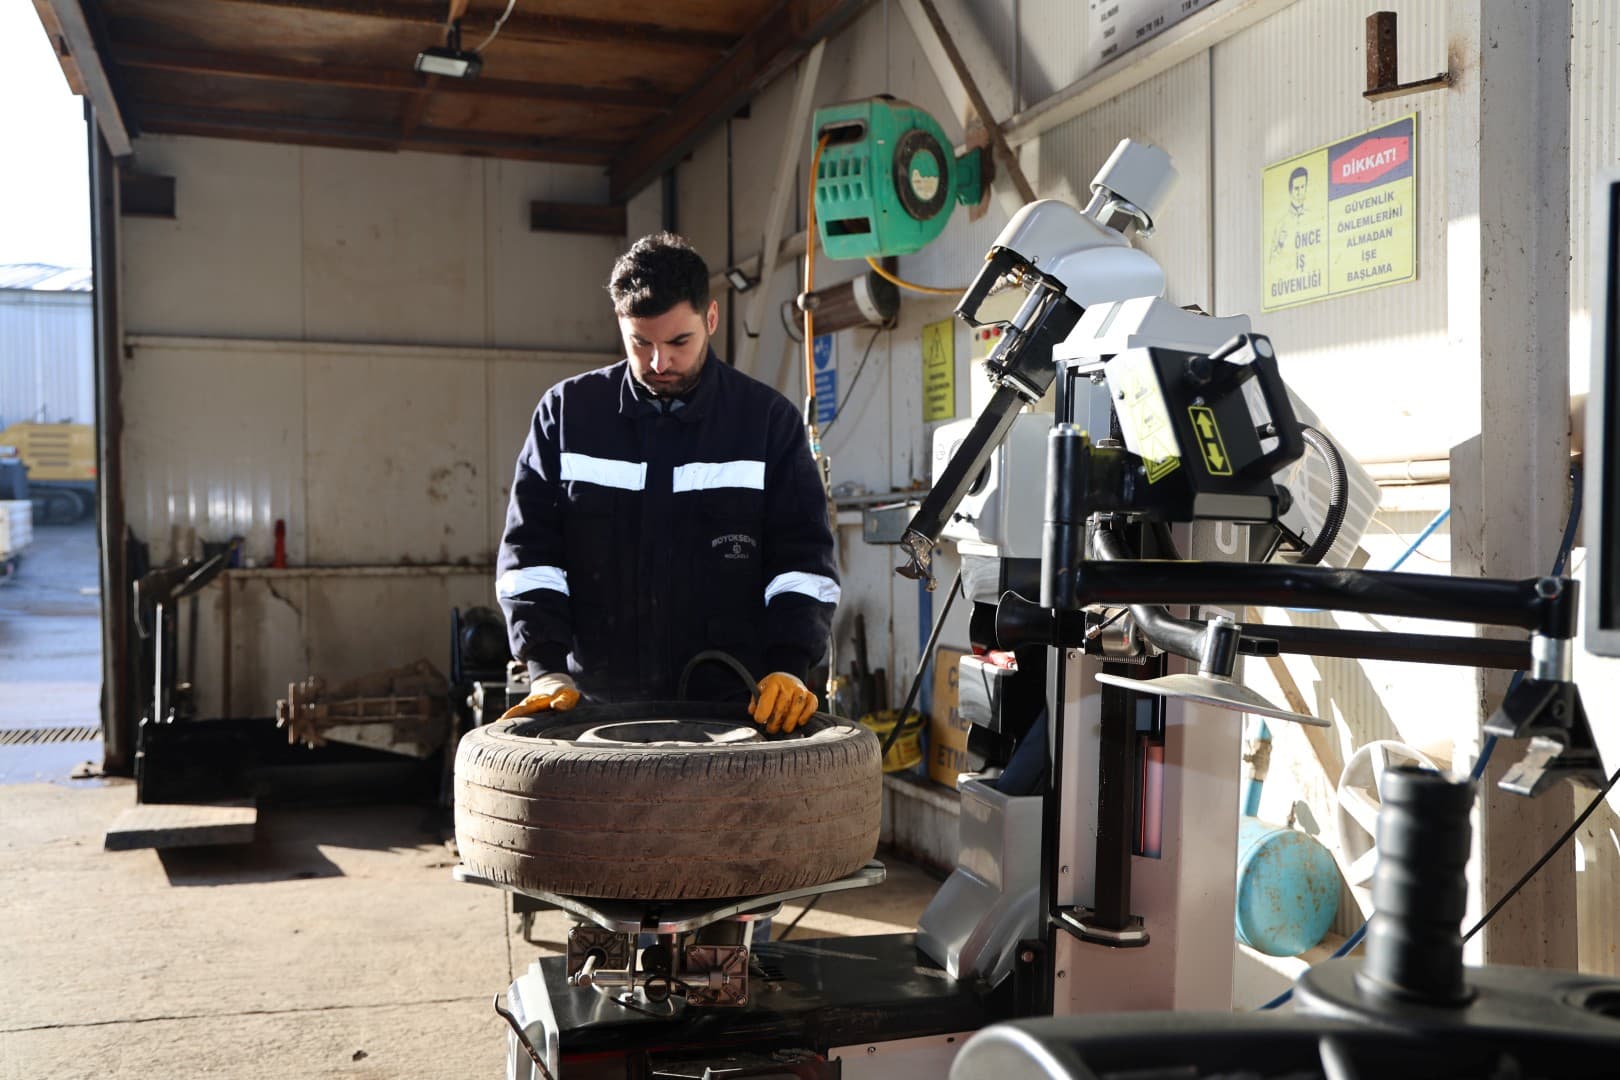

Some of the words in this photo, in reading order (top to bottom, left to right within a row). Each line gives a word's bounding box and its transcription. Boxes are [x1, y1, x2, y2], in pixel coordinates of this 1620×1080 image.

[1342, 148, 1397, 177] DİKKAT!
[1344, 191, 1394, 214] GÜVENLİK
[1337, 207, 1403, 233] ÖNLEMLERİNİ
[1294, 229, 1321, 249] ÖNCE
[1346, 227, 1393, 248] ALMADAN
[1296, 252, 1306, 272] İŞ
[1361, 248, 1377, 262] İŞE
[1271, 269, 1321, 297] GÜVENLİĞİ
[1347, 263, 1393, 282] BAŞLAMA
